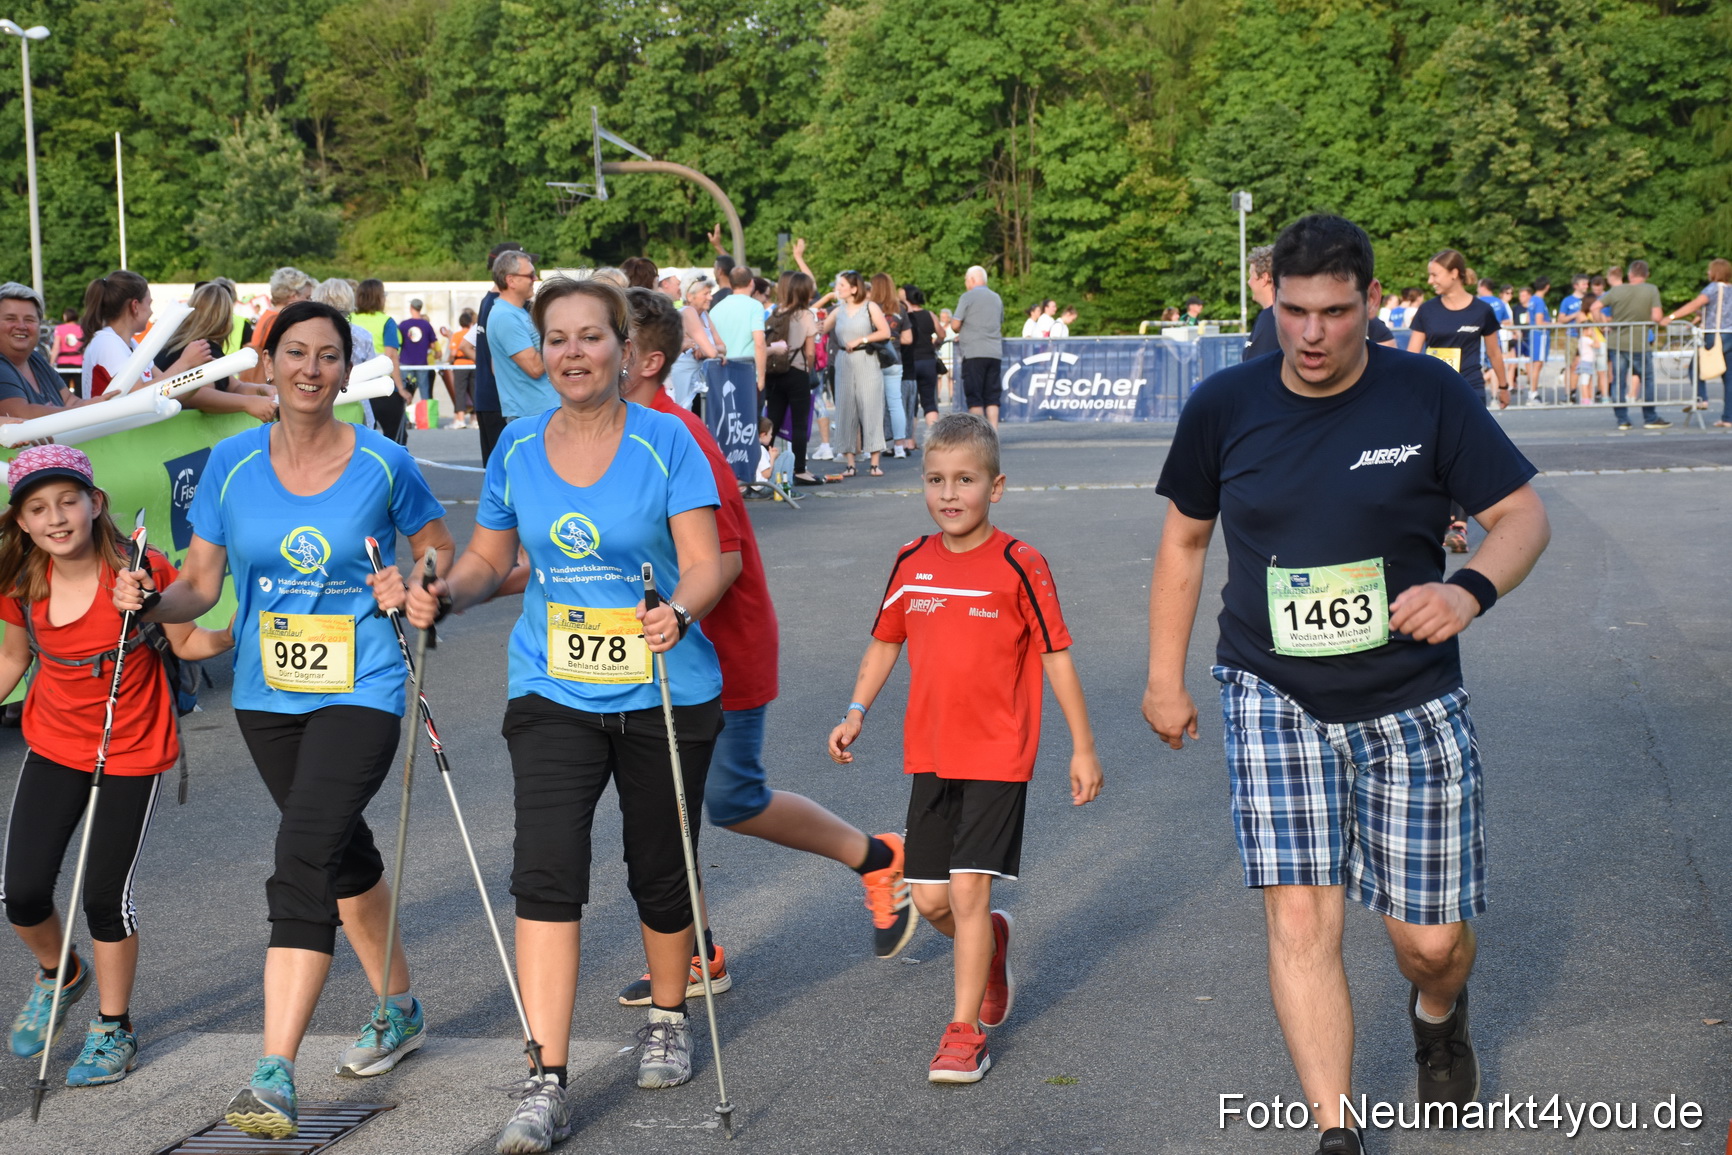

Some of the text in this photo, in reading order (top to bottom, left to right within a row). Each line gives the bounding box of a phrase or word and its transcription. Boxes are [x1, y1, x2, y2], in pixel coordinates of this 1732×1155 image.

[1027, 372, 1148, 396] Fischer
[1038, 399, 1137, 410] AUTOMOBILE
[1349, 447, 1401, 470] JURA
[549, 564, 623, 574] Handwerkskammer
[905, 598, 931, 614] JURA
[968, 607, 998, 619] Michael
[1284, 594, 1373, 631] 1463
[1289, 626, 1372, 641] Wodianka Michael
[274, 641, 328, 670] 982
[567, 633, 627, 662] 978
[567, 660, 599, 670] Behland
[294, 671, 325, 680] Dagmar
[679, 793, 690, 838] PLATINIUM
